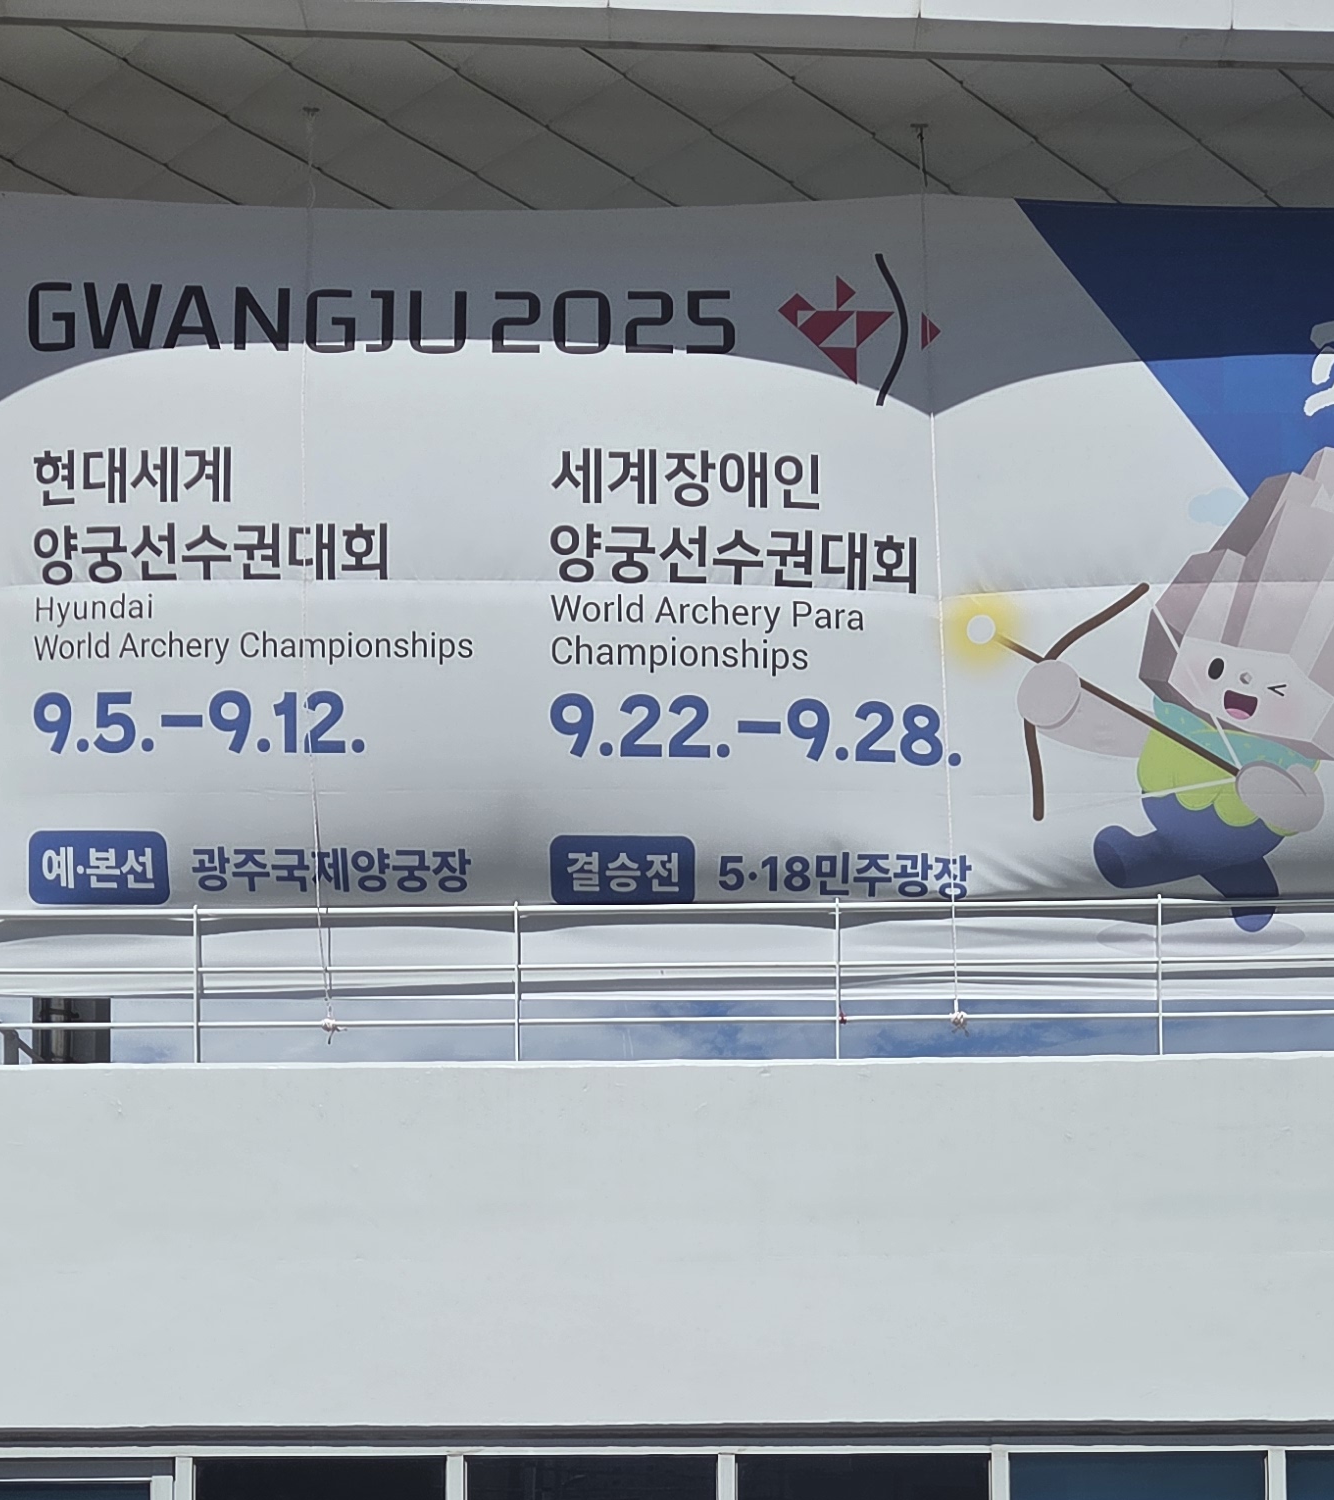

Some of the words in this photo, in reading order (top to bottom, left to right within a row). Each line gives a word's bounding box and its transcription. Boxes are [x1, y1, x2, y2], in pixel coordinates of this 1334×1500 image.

[27, 280, 468, 354] GWANGJU
[491, 290, 736, 354] 2025
[33, 446, 232, 506] 현대세계
[550, 447, 821, 510] 세계장애인
[33, 522, 389, 585] 양궁선수권대회
[548, 523, 918, 595] 양궁선수권대회
[34, 593, 154, 627] Hyundai
[550, 594, 645, 624] World
[654, 597, 781, 634] Archery
[792, 600, 866, 631] Para
[33, 632, 111, 662] World
[118, 632, 230, 666] Archery
[240, 631, 474, 666] Championships
[550, 635, 809, 677] Championships
[191, 846, 471, 894] 광주국제양궁장
[565, 850, 681, 894] 결승전
